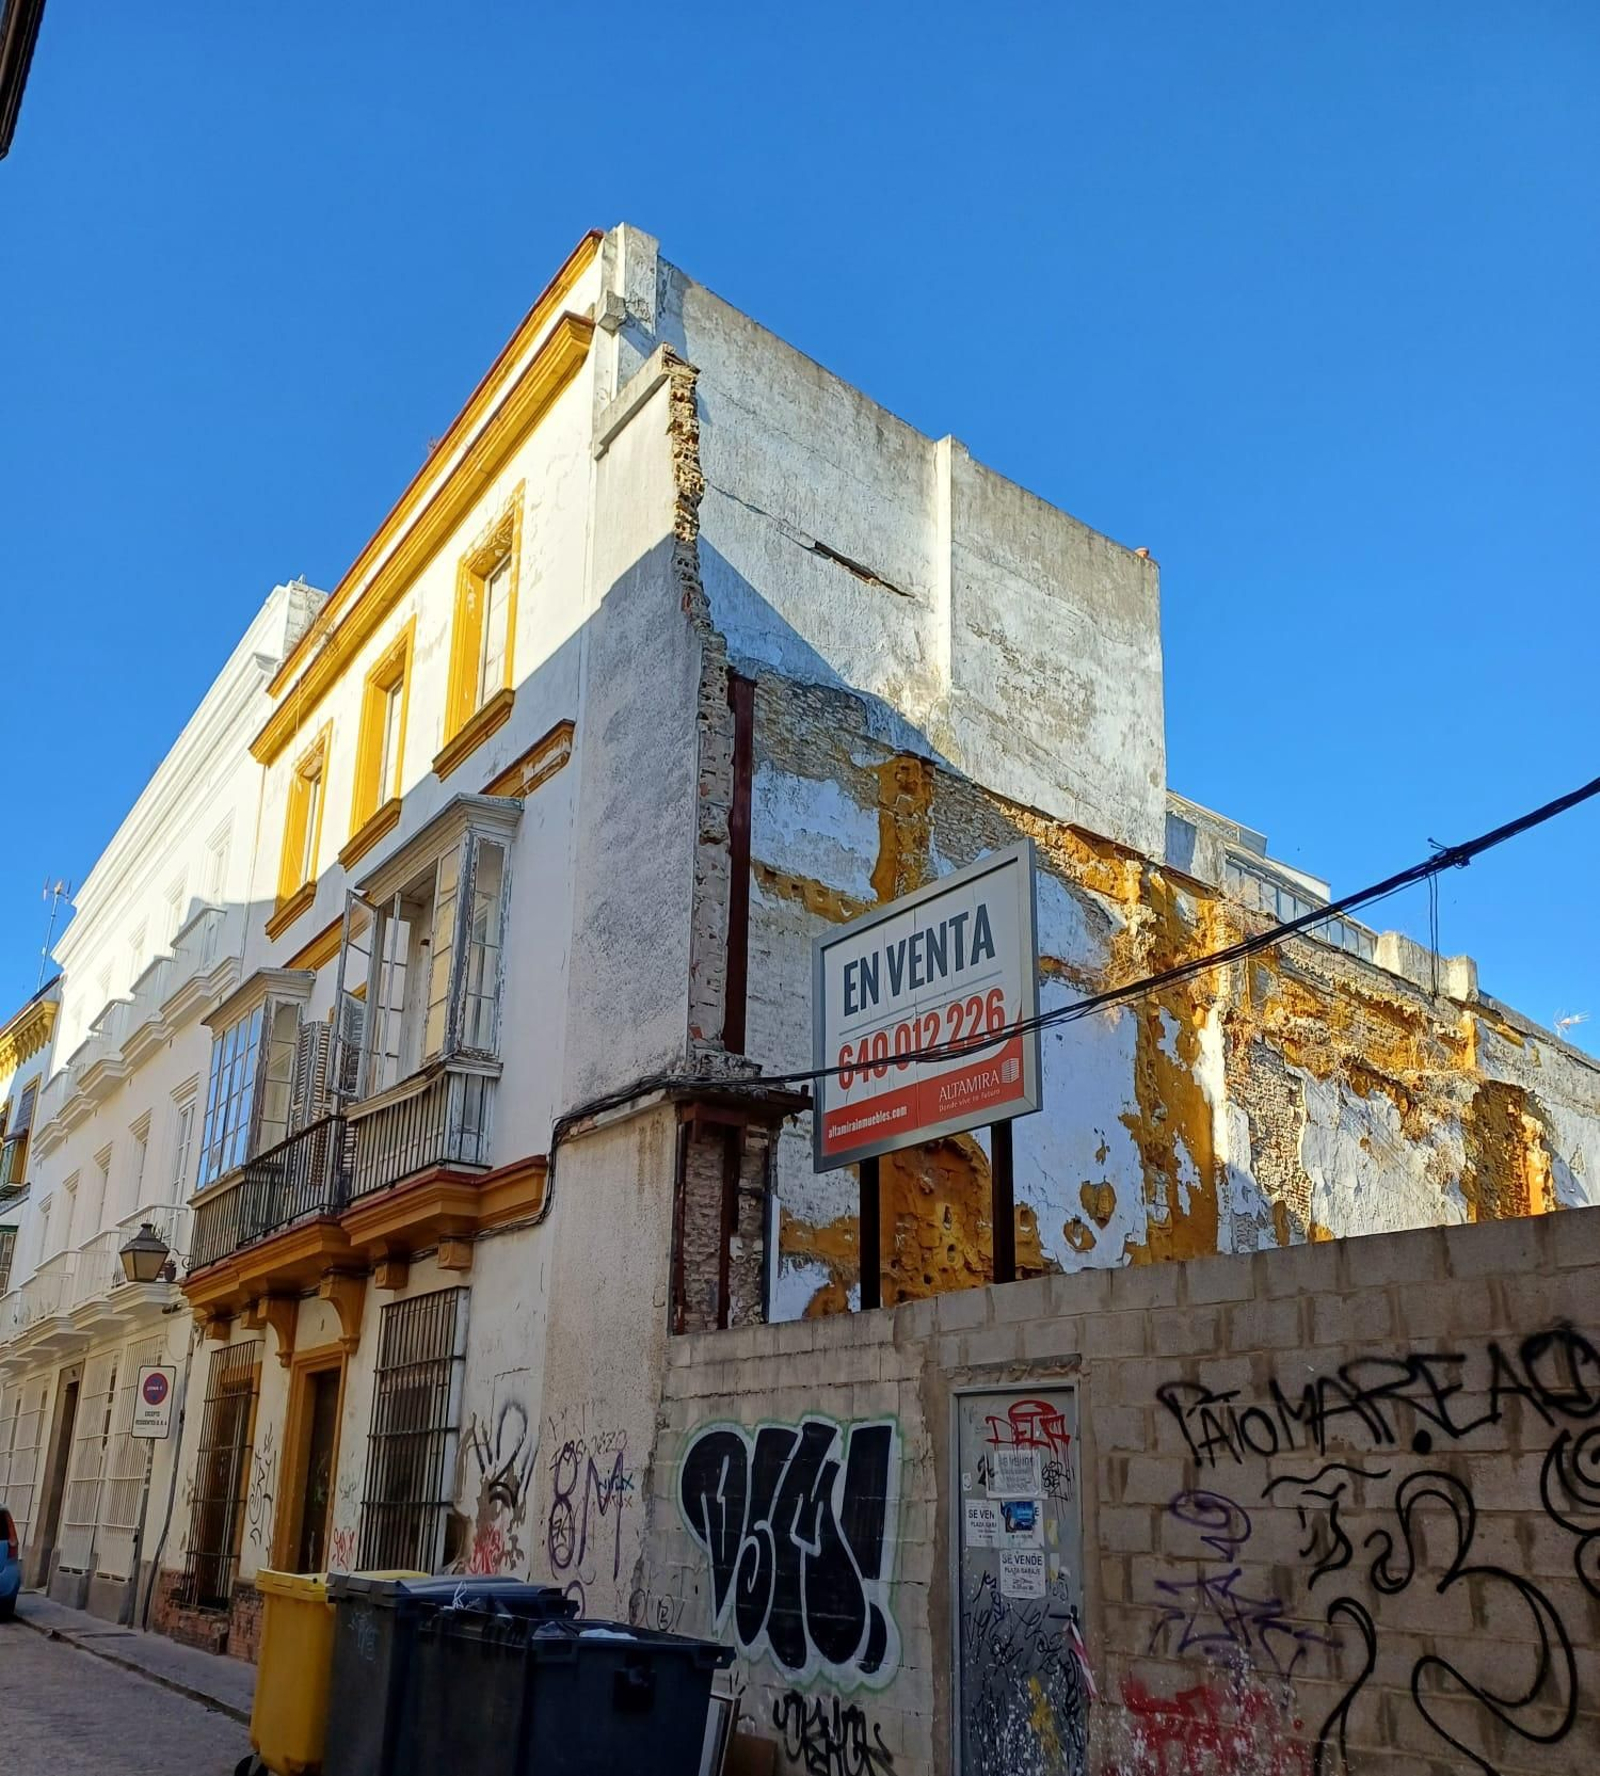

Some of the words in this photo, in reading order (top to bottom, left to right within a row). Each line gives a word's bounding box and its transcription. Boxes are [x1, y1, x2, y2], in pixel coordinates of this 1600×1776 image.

[843, 951, 880, 1017] EN
[886, 903, 996, 997] VENTA
[838, 1032, 888, 1091] 640
[894, 1011, 941, 1070] 012
[946, 987, 1005, 1053] 226
[939, 1069, 1000, 1102] ALTAMIRA
[828, 1105, 908, 1139] altamirainmuebles.com
[968, 1509, 978, 1519] SE
[1002, 1553, 1013, 1565] SE
[1014, 1554, 1043, 1566] VENDE
